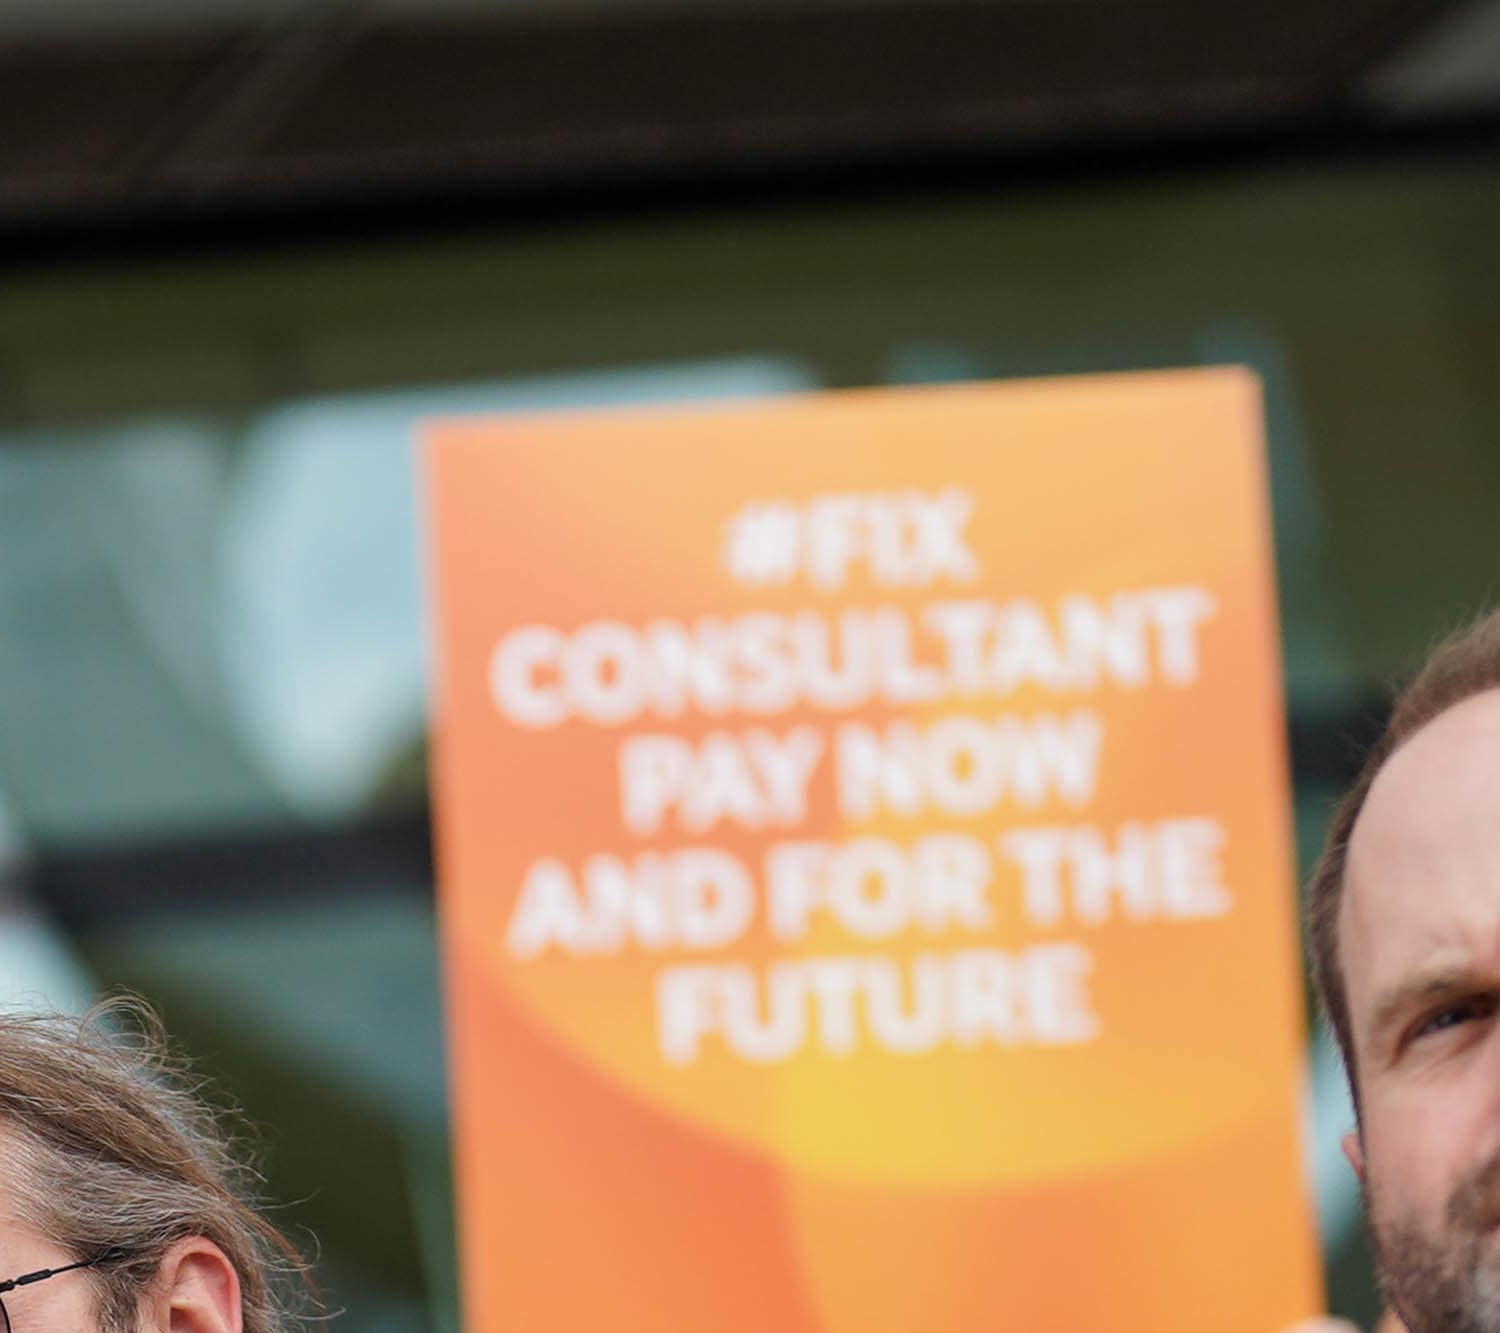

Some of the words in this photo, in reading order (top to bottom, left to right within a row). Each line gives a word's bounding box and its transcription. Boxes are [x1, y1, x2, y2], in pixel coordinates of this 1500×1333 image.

[719, 484, 980, 592] #FIX
[489, 585, 1218, 729] CONSULTANT
[618, 725, 826, 834] PAY
[834, 708, 1105, 821] NOW
[506, 848, 756, 958] AND
[765, 832, 994, 941] FOR
[999, 817, 1233, 925] THE
[656, 942, 1099, 1064] FUTURE
